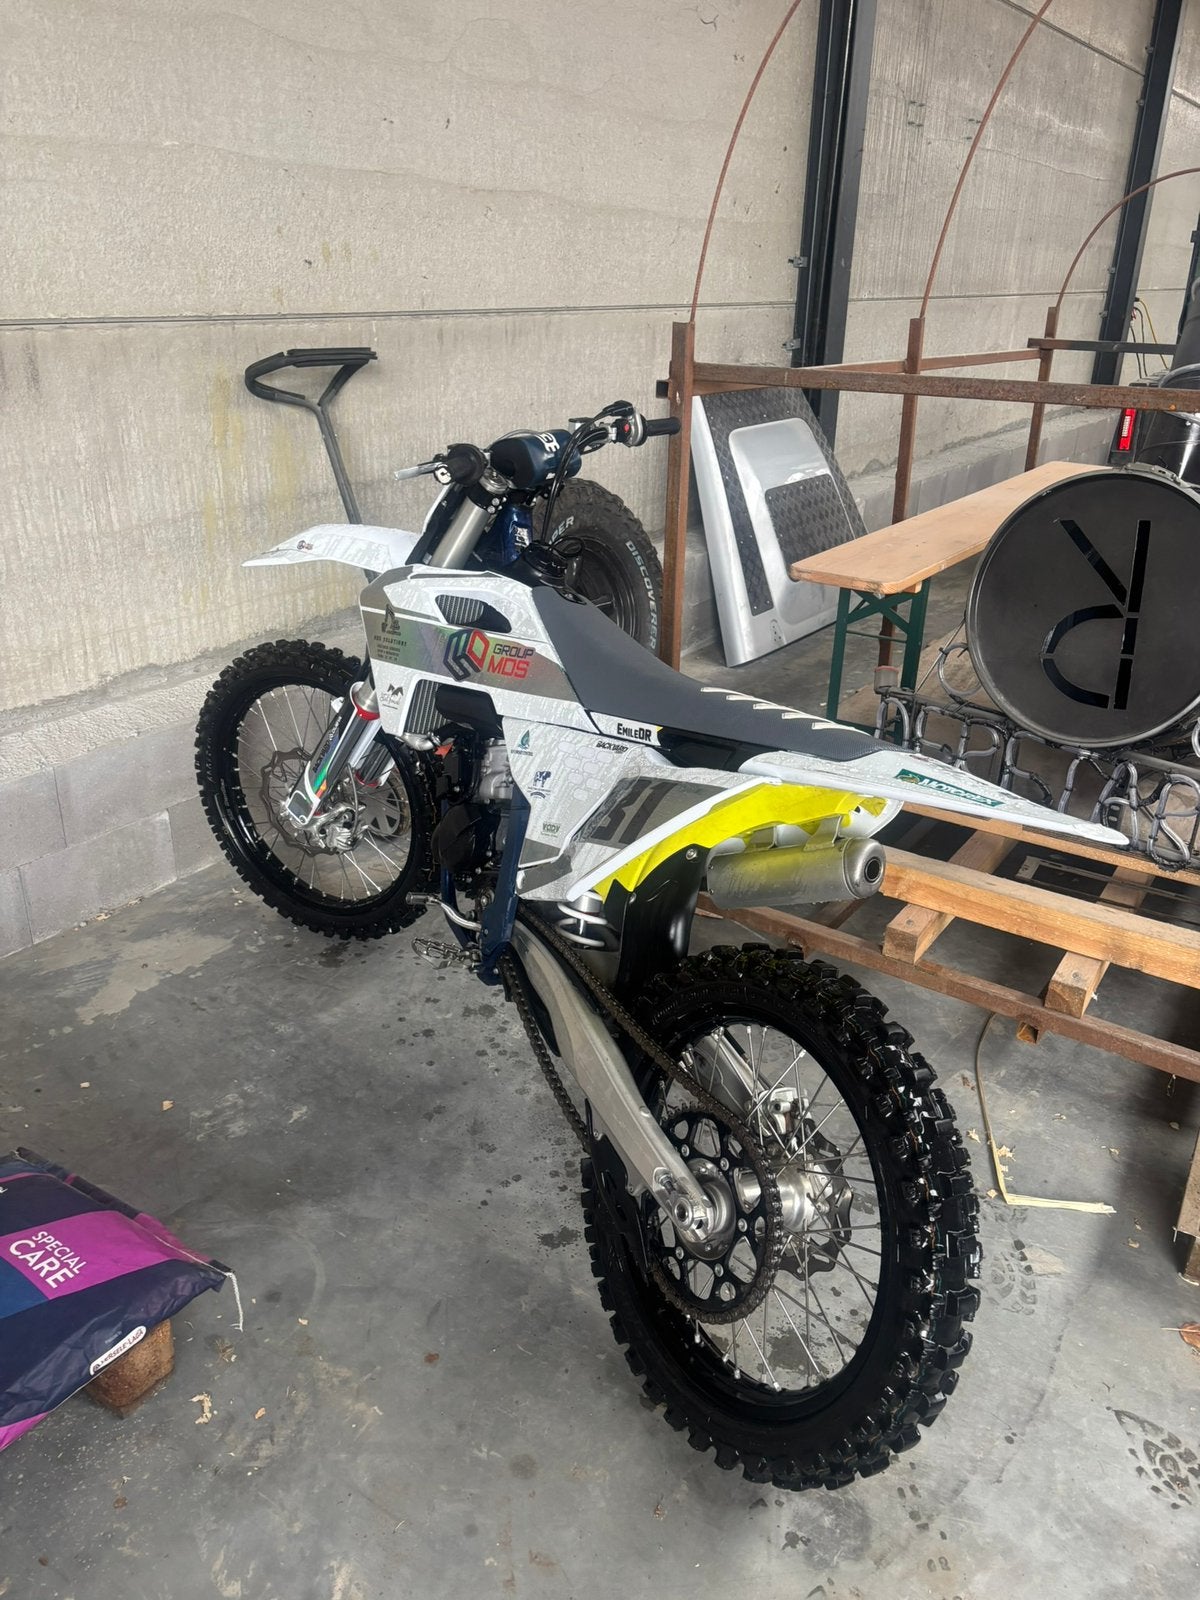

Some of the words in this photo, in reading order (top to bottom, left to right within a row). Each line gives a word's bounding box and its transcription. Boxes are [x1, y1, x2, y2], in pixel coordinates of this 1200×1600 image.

[625, 540, 659, 650] DISCOVERER
[487, 655, 530, 679] MDS
[493, 643, 534, 659] GROUP
[919, 778, 993, 806] MOTOREX
[9, 1239, 75, 1289] CARE
[32, 1231, 87, 1275] SPECIAL
